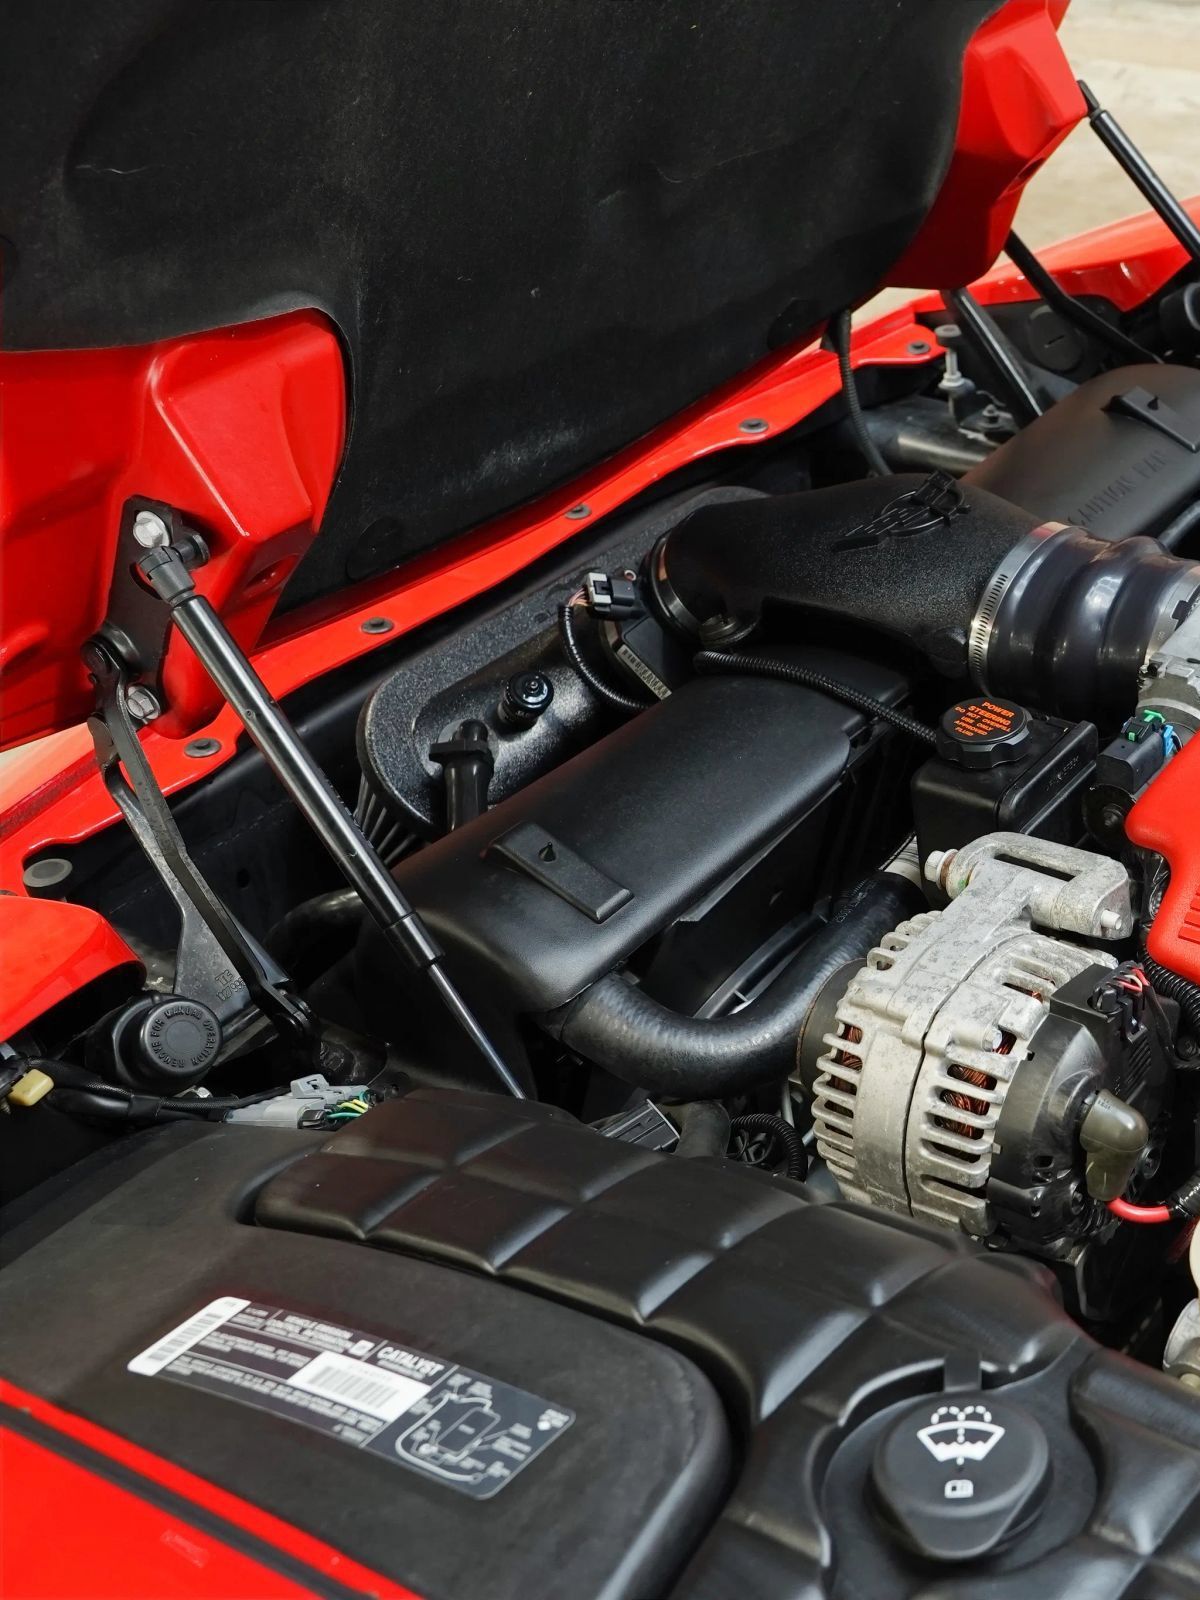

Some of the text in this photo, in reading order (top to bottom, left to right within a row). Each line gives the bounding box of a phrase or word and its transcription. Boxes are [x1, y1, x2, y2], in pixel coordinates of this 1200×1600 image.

[968, 705, 1012, 726] STEERING
[982, 702, 1015, 717] POWER
[150, 1018, 165, 1038] FOR
[164, 1005, 203, 1020] MANUAL
[376, 1346, 446, 1378] CATALYST
